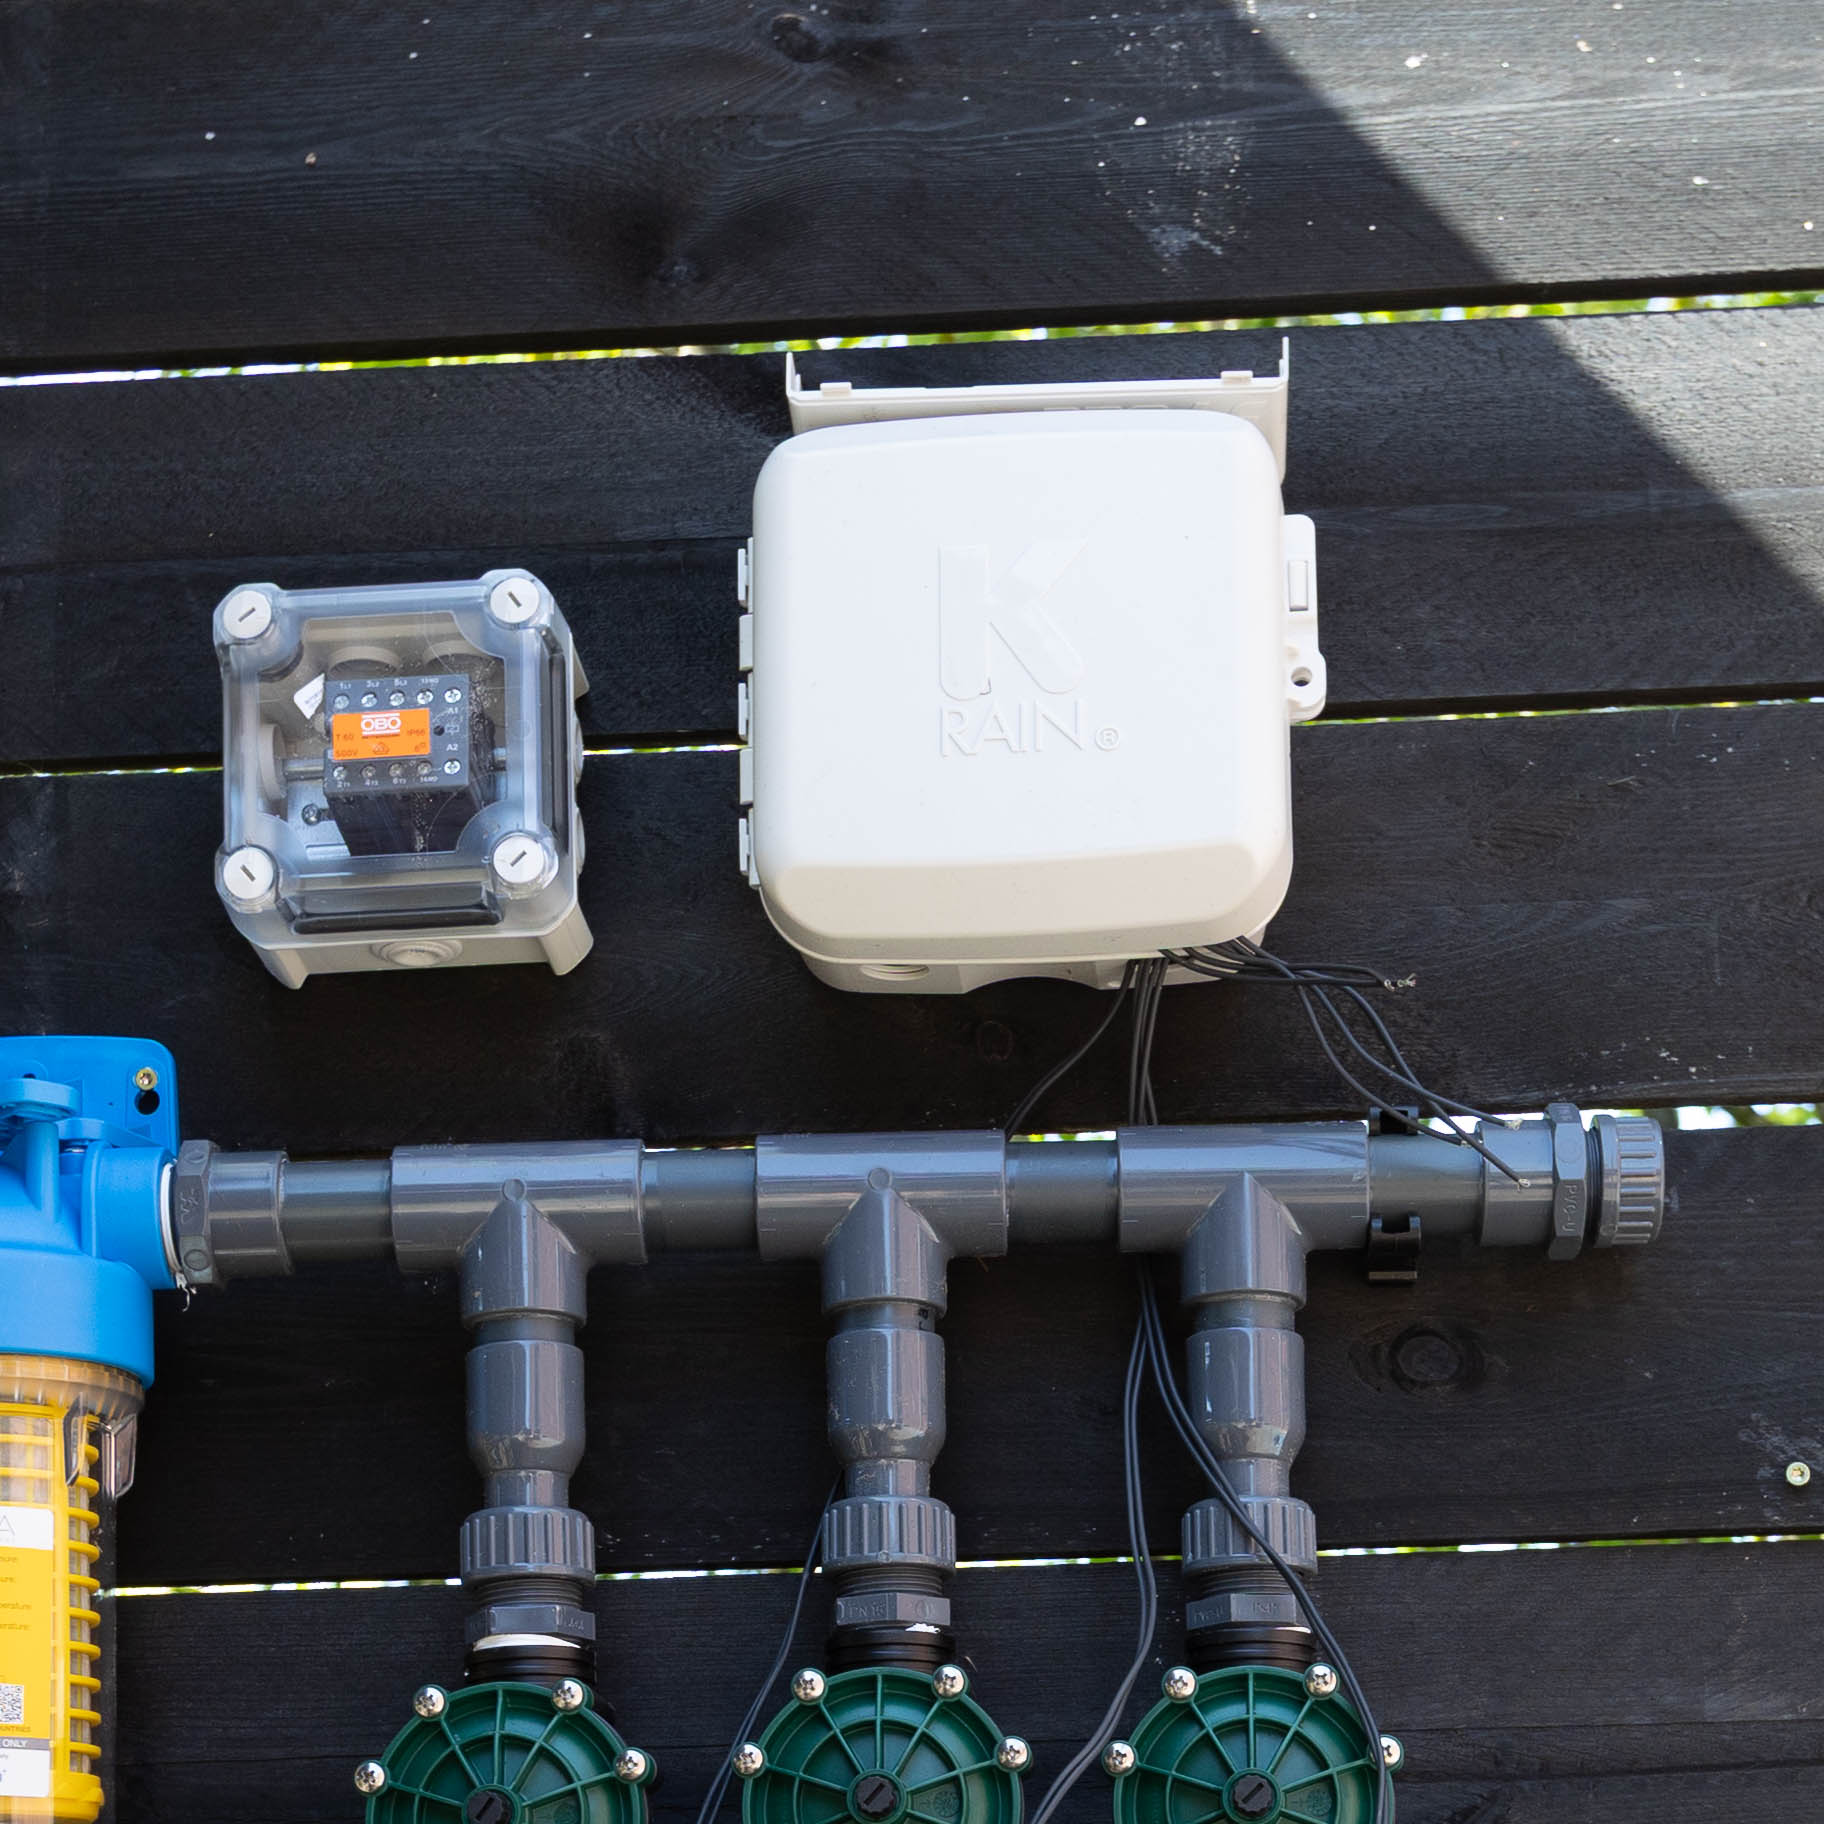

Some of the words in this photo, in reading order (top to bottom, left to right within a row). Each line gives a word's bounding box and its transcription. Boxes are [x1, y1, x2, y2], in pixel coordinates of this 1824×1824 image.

[936, 536, 1088, 703] K
[361, 716, 402, 731] OBO
[446, 743, 459, 752] A2
[2, 1739, 27, 1748] ONLY
